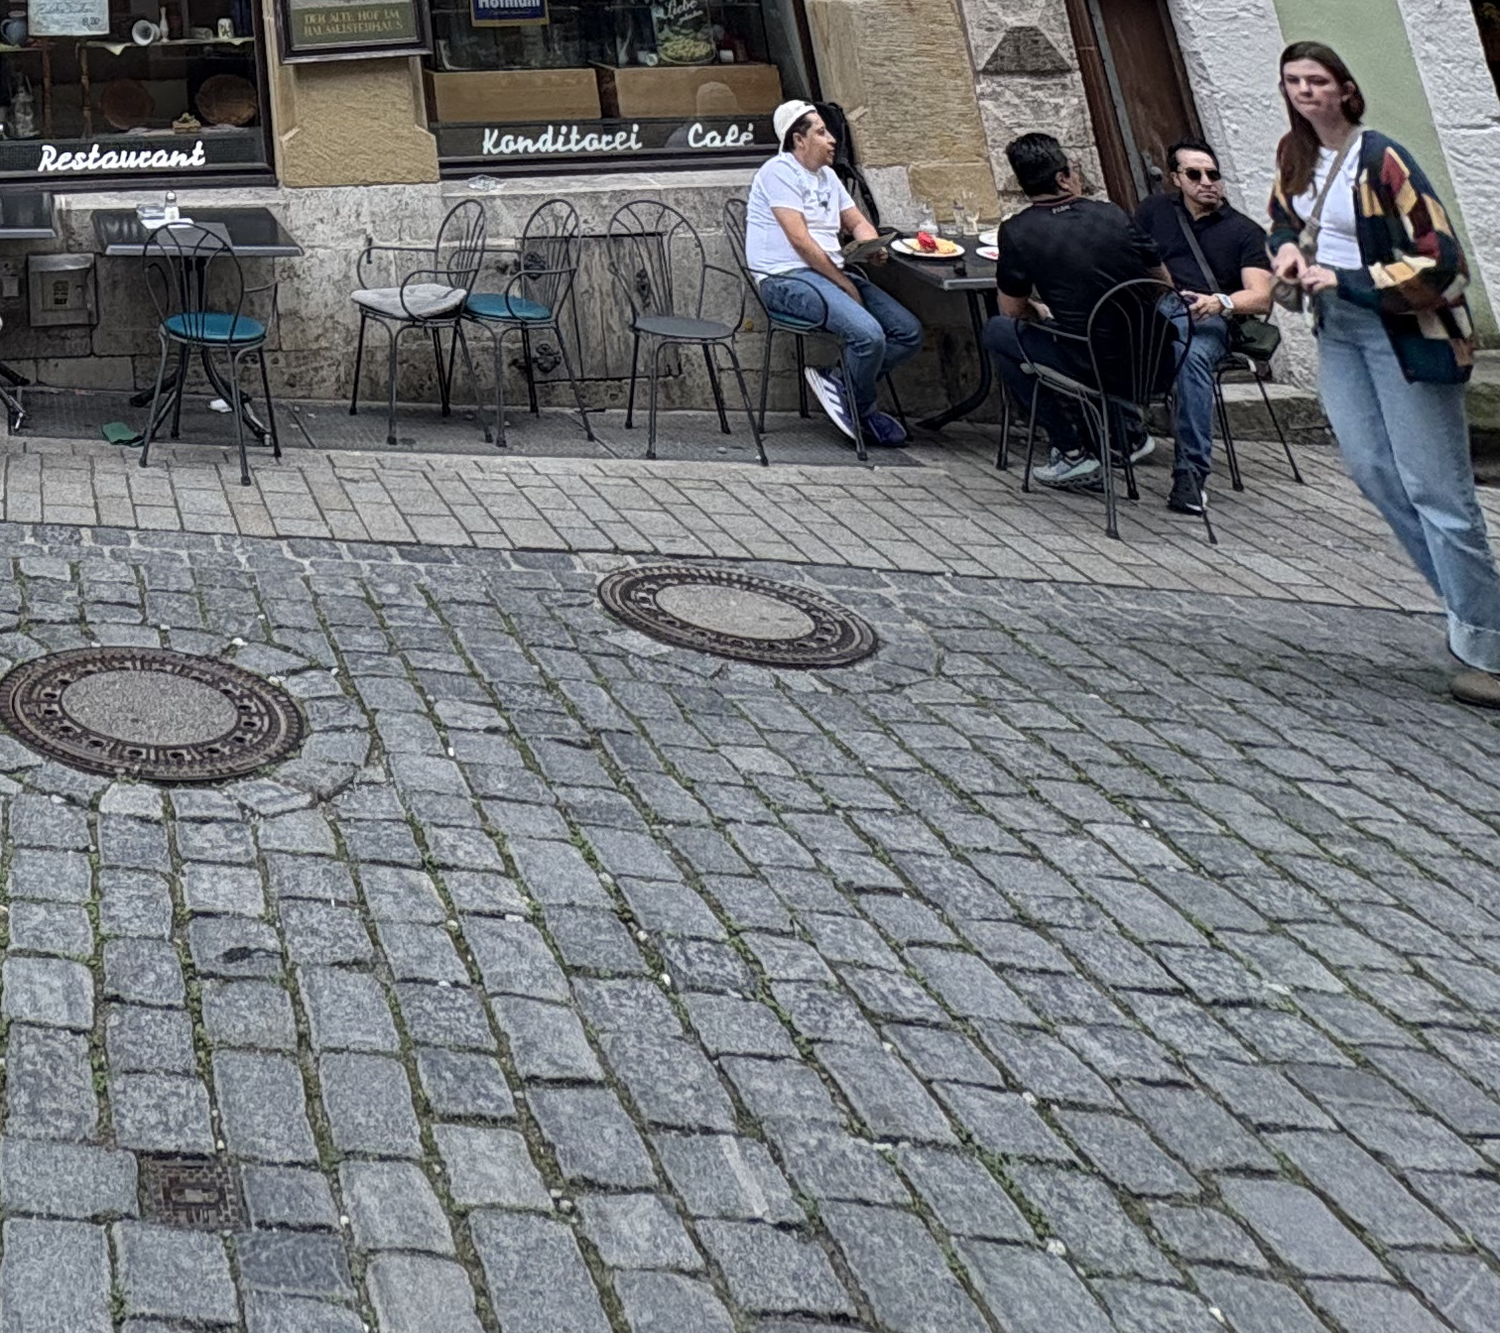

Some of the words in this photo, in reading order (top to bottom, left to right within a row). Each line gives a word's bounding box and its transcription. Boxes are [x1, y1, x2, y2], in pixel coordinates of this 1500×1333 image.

[303, 20, 404, 37] BAUMEISTERHAUS
[304, 13, 326, 25] DER
[357, 10, 381, 21] HOF
[482, 123, 643, 155] Konditorei
[687, 122, 755, 148] Café
[37, 140, 206, 172] Restaurant
